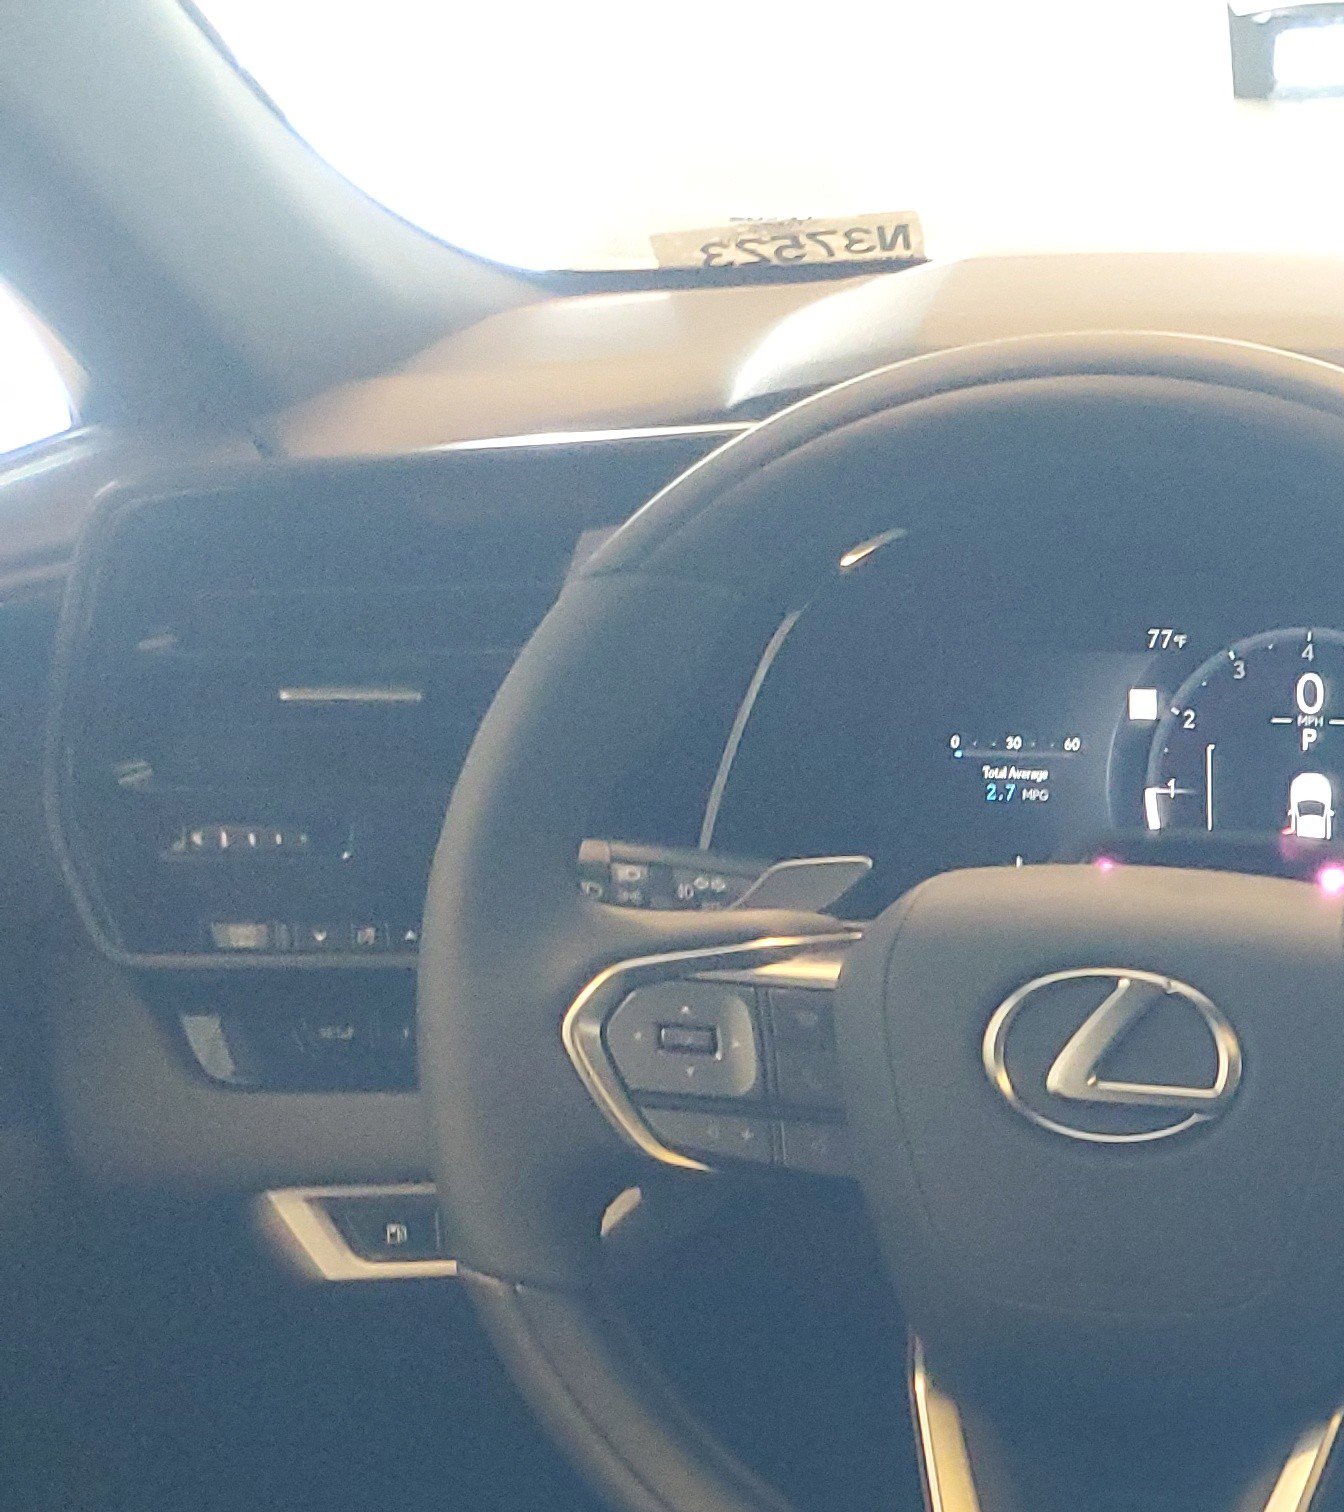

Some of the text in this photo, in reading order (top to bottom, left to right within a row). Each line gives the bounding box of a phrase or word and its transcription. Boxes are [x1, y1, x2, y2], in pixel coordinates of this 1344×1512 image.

[1301, 643, 1315, 661] 4
[1233, 660, 1246, 679] 3
[1296, 672, 1325, 715] 0
[1183, 709, 1196, 729] 2
[1297, 714, 1324, 727] MPH
[950, 734, 1081, 752] 0 30 60
[1302, 728, 1318, 751] P
[982, 764, 1049, 783] Total Average
[986, 782, 1049, 802] 2.7 MPG
[1166, 778, 1176, 799] 1
